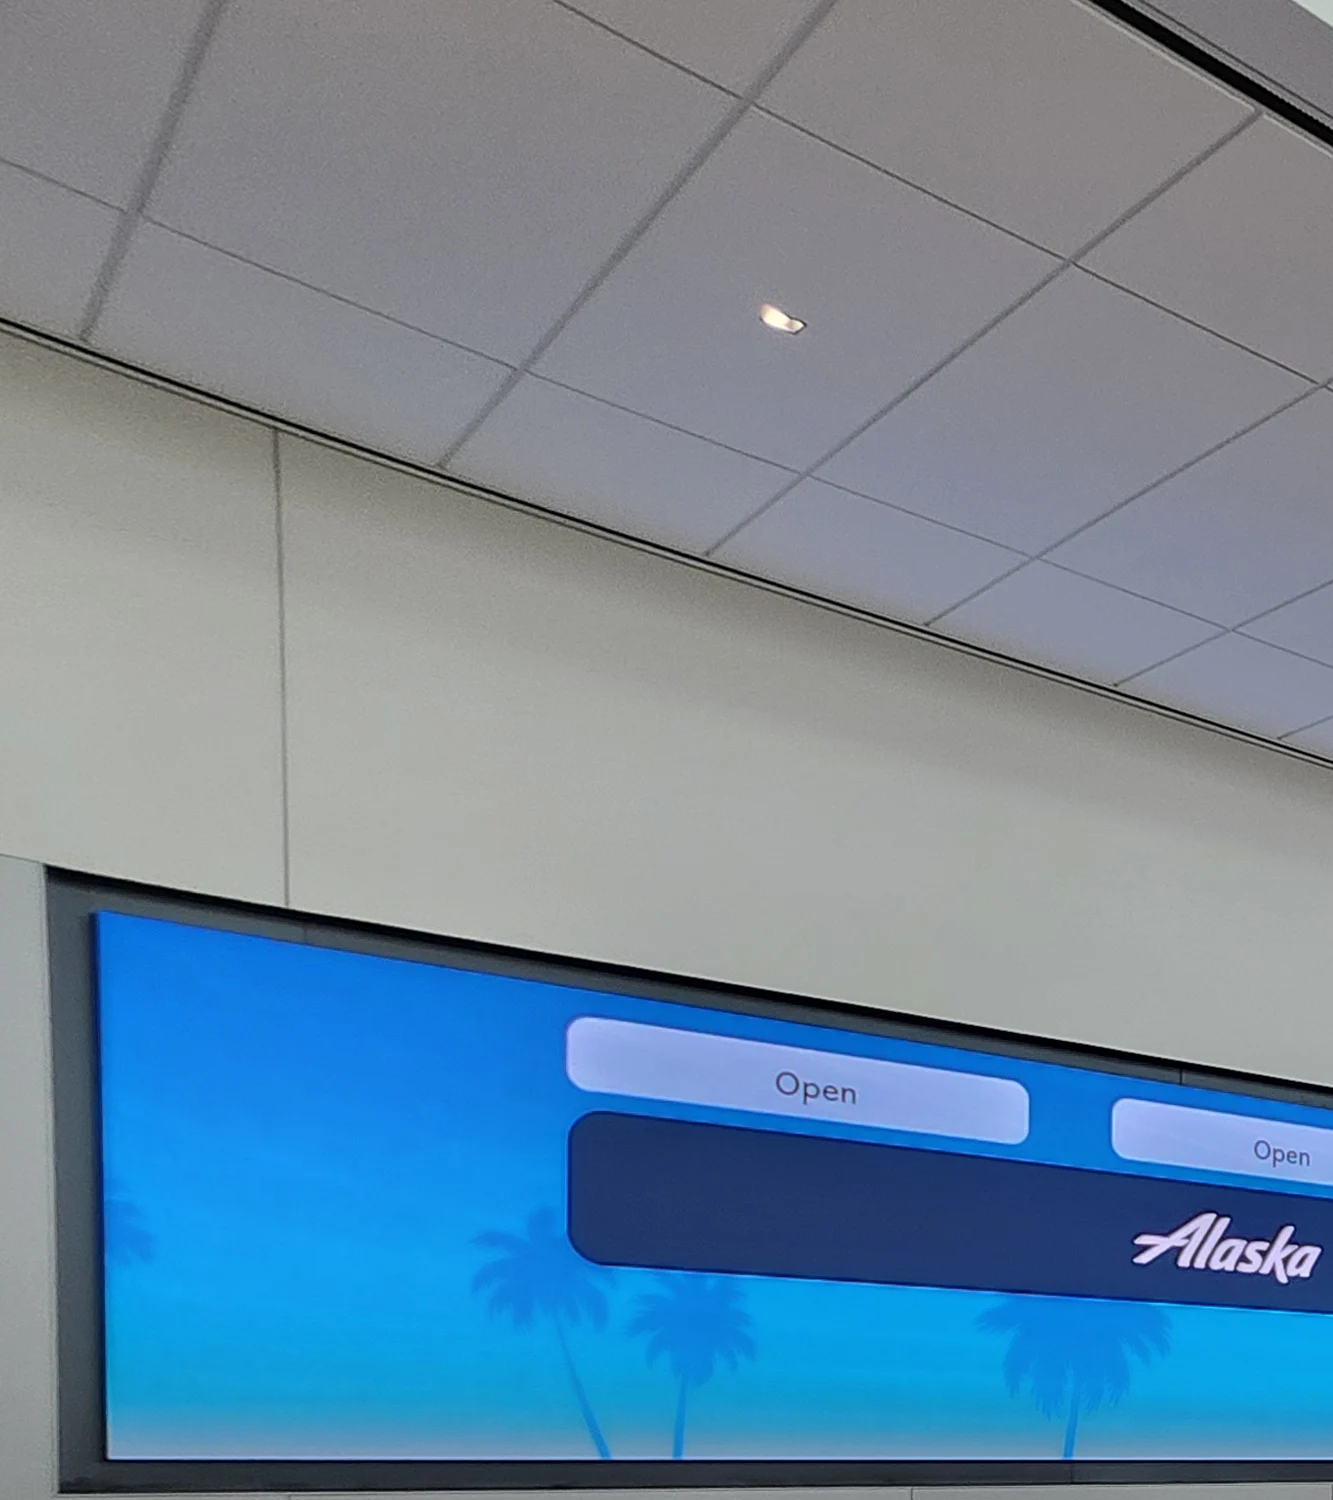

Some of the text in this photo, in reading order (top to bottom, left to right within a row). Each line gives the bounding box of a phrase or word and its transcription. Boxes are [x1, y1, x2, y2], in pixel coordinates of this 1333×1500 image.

[776, 1071, 856, 1105] Open
[1254, 1140, 1310, 1168] Open
[1132, 1212, 1322, 1284] Alaska
